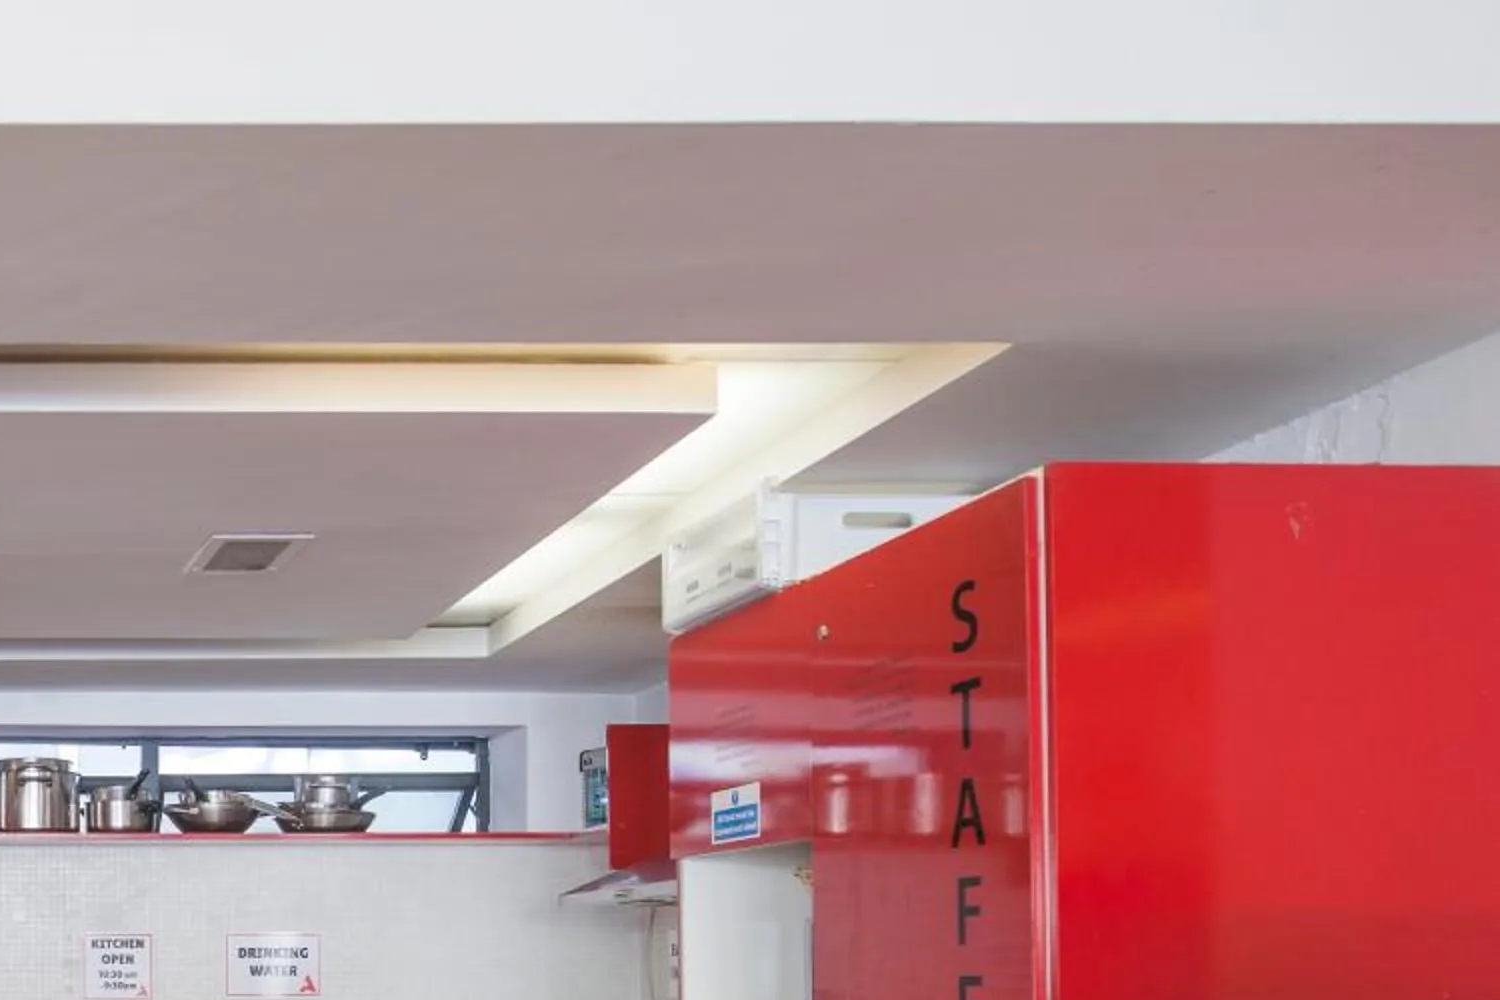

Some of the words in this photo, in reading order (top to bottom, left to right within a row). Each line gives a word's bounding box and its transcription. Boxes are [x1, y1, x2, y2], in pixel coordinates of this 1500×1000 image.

[91, 938, 145, 950] KITCHEN
[237, 946, 309, 959] DRINKING
[101, 953, 135, 965] OPEN
[249, 964, 298, 977] WATER
